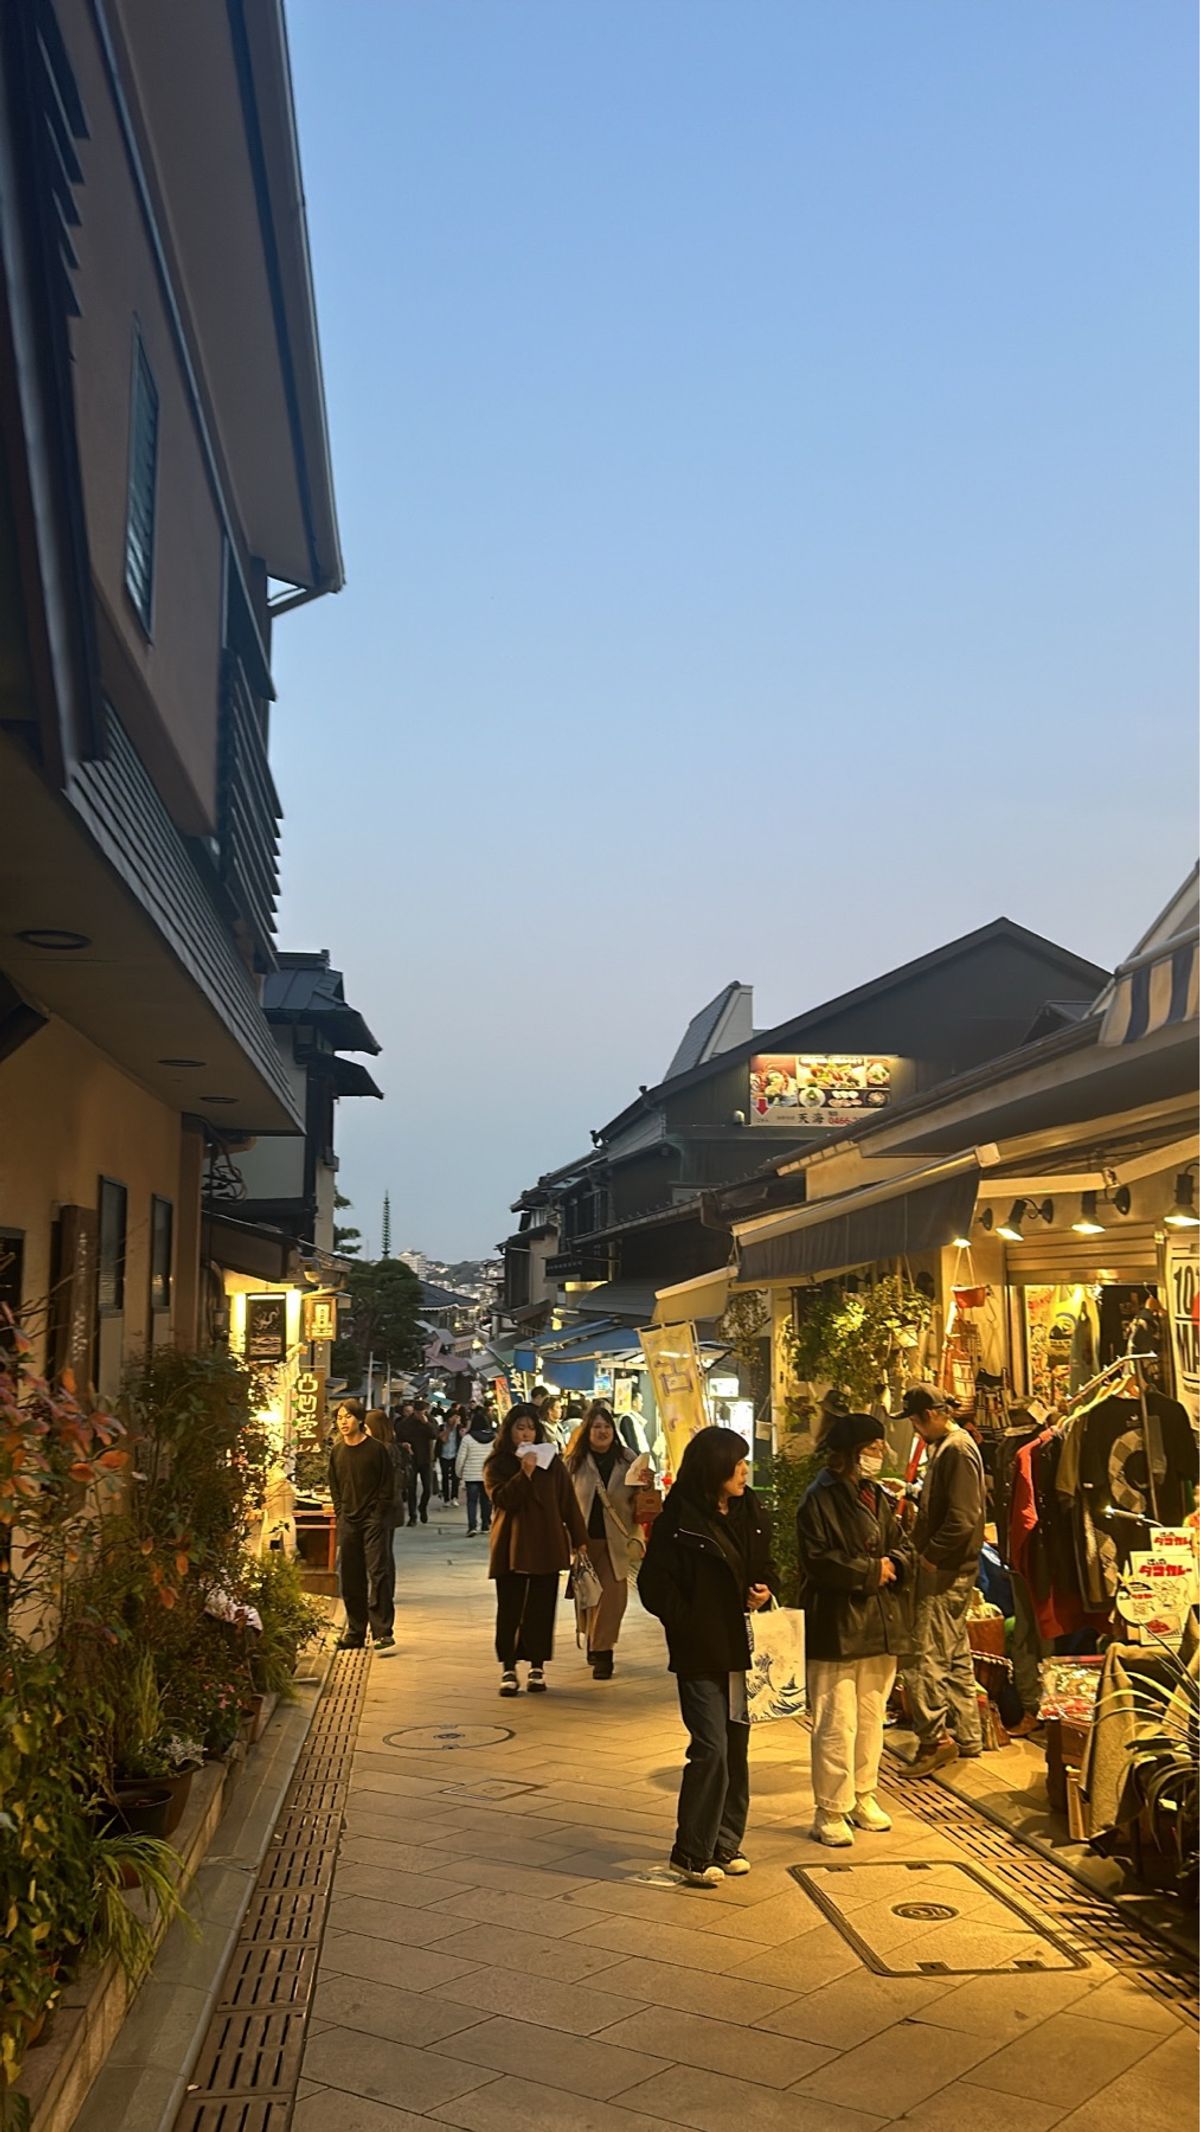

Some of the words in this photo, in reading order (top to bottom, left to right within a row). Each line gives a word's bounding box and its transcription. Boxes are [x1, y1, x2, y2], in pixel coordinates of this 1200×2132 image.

[1139, 1564, 1192, 1577] タコカレー
